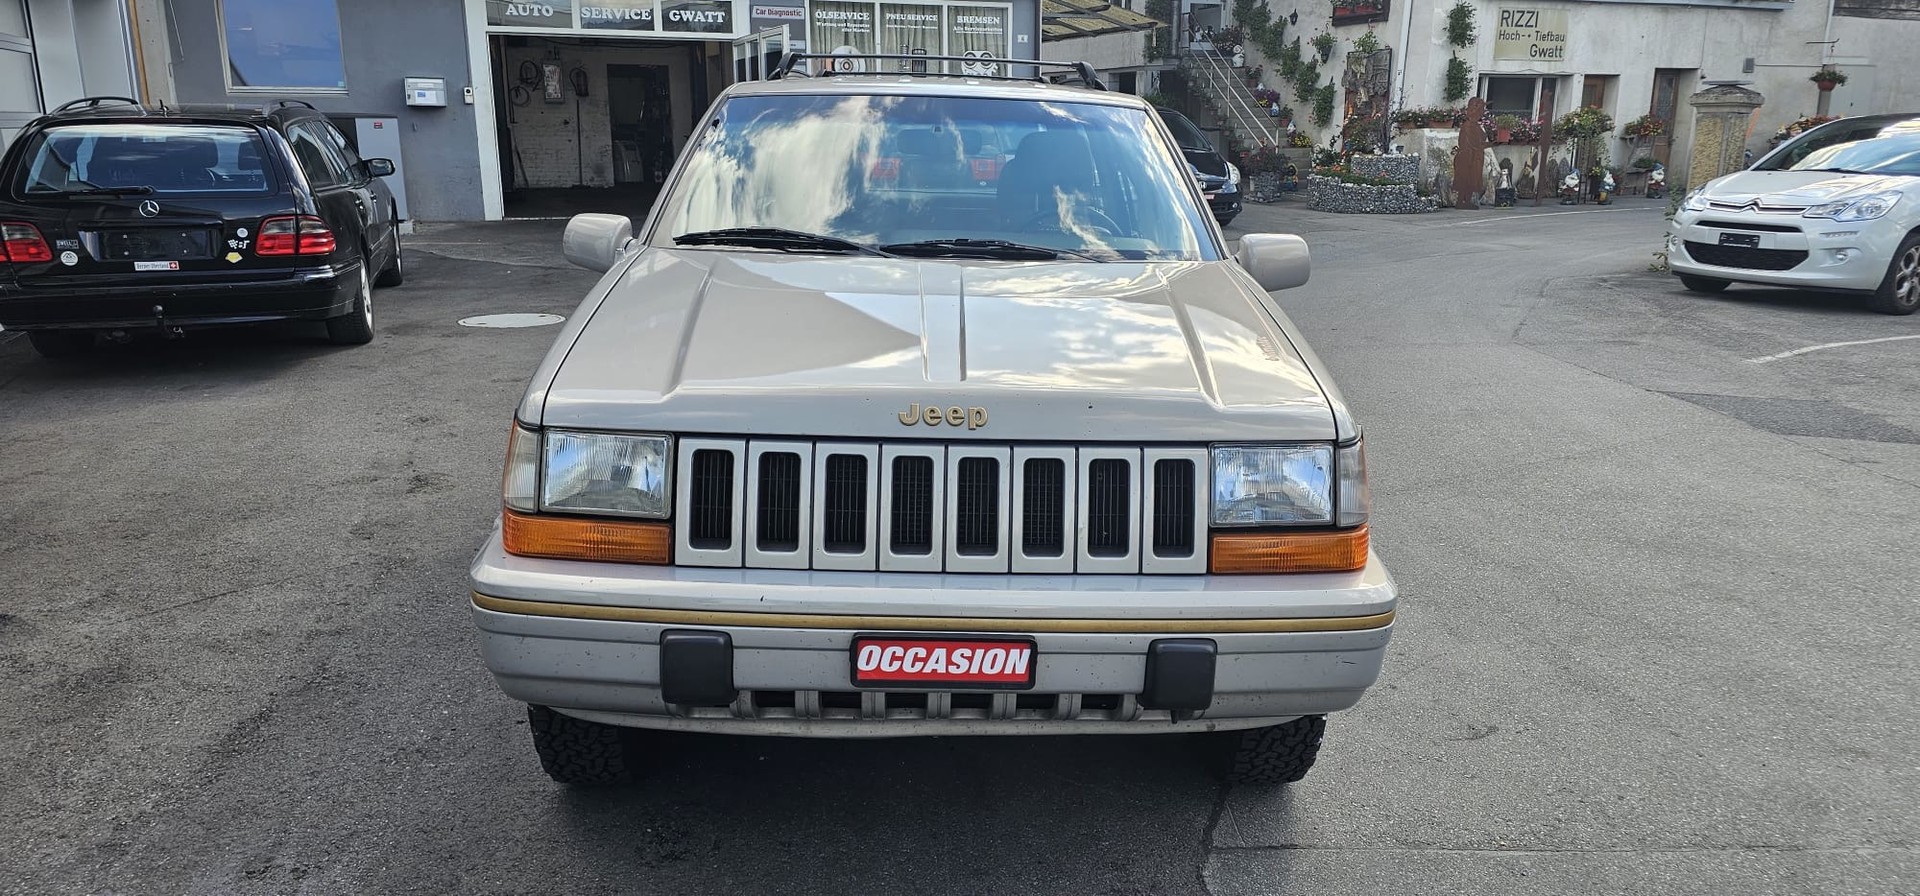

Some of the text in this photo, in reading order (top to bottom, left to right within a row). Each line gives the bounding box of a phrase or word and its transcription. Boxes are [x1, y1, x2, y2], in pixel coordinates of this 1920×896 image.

[505, 4, 725, 23] AUTO SERVICE GWATT
[768, 8, 802, 17] Diagnostic
[957, 16, 1000, 25] BREMSEN
[1500, 10, 1539, 28] RIZZI
[1535, 30, 1565, 42] Tiefbau
[1529, 43, 1563, 58] Gwatt
[898, 402, 988, 431] Jeep
[857, 645, 1032, 675] OCCASION
